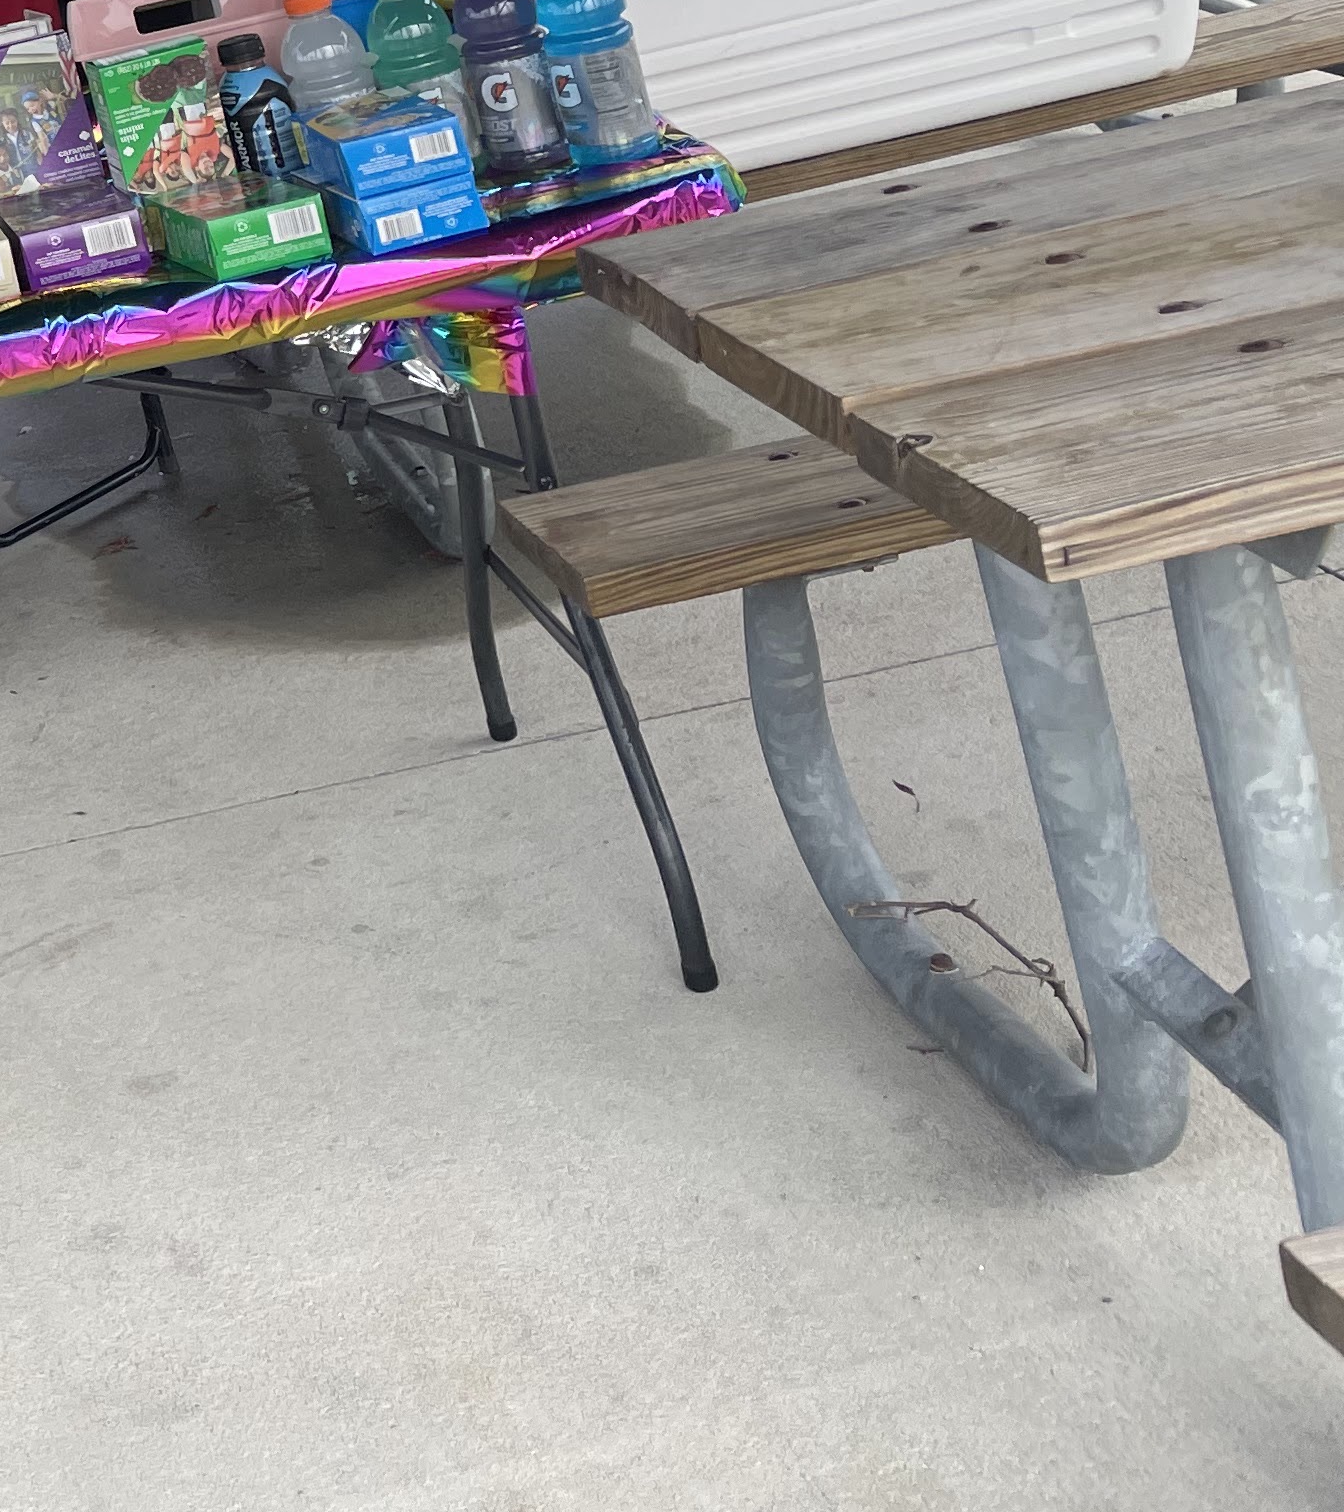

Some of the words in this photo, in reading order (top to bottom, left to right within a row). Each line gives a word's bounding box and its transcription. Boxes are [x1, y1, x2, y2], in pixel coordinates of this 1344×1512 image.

[481, 72, 519, 112] G
[551, 64, 583, 108] G
[57, 142, 94, 158] caramel
[64, 151, 97, 165] deLites
